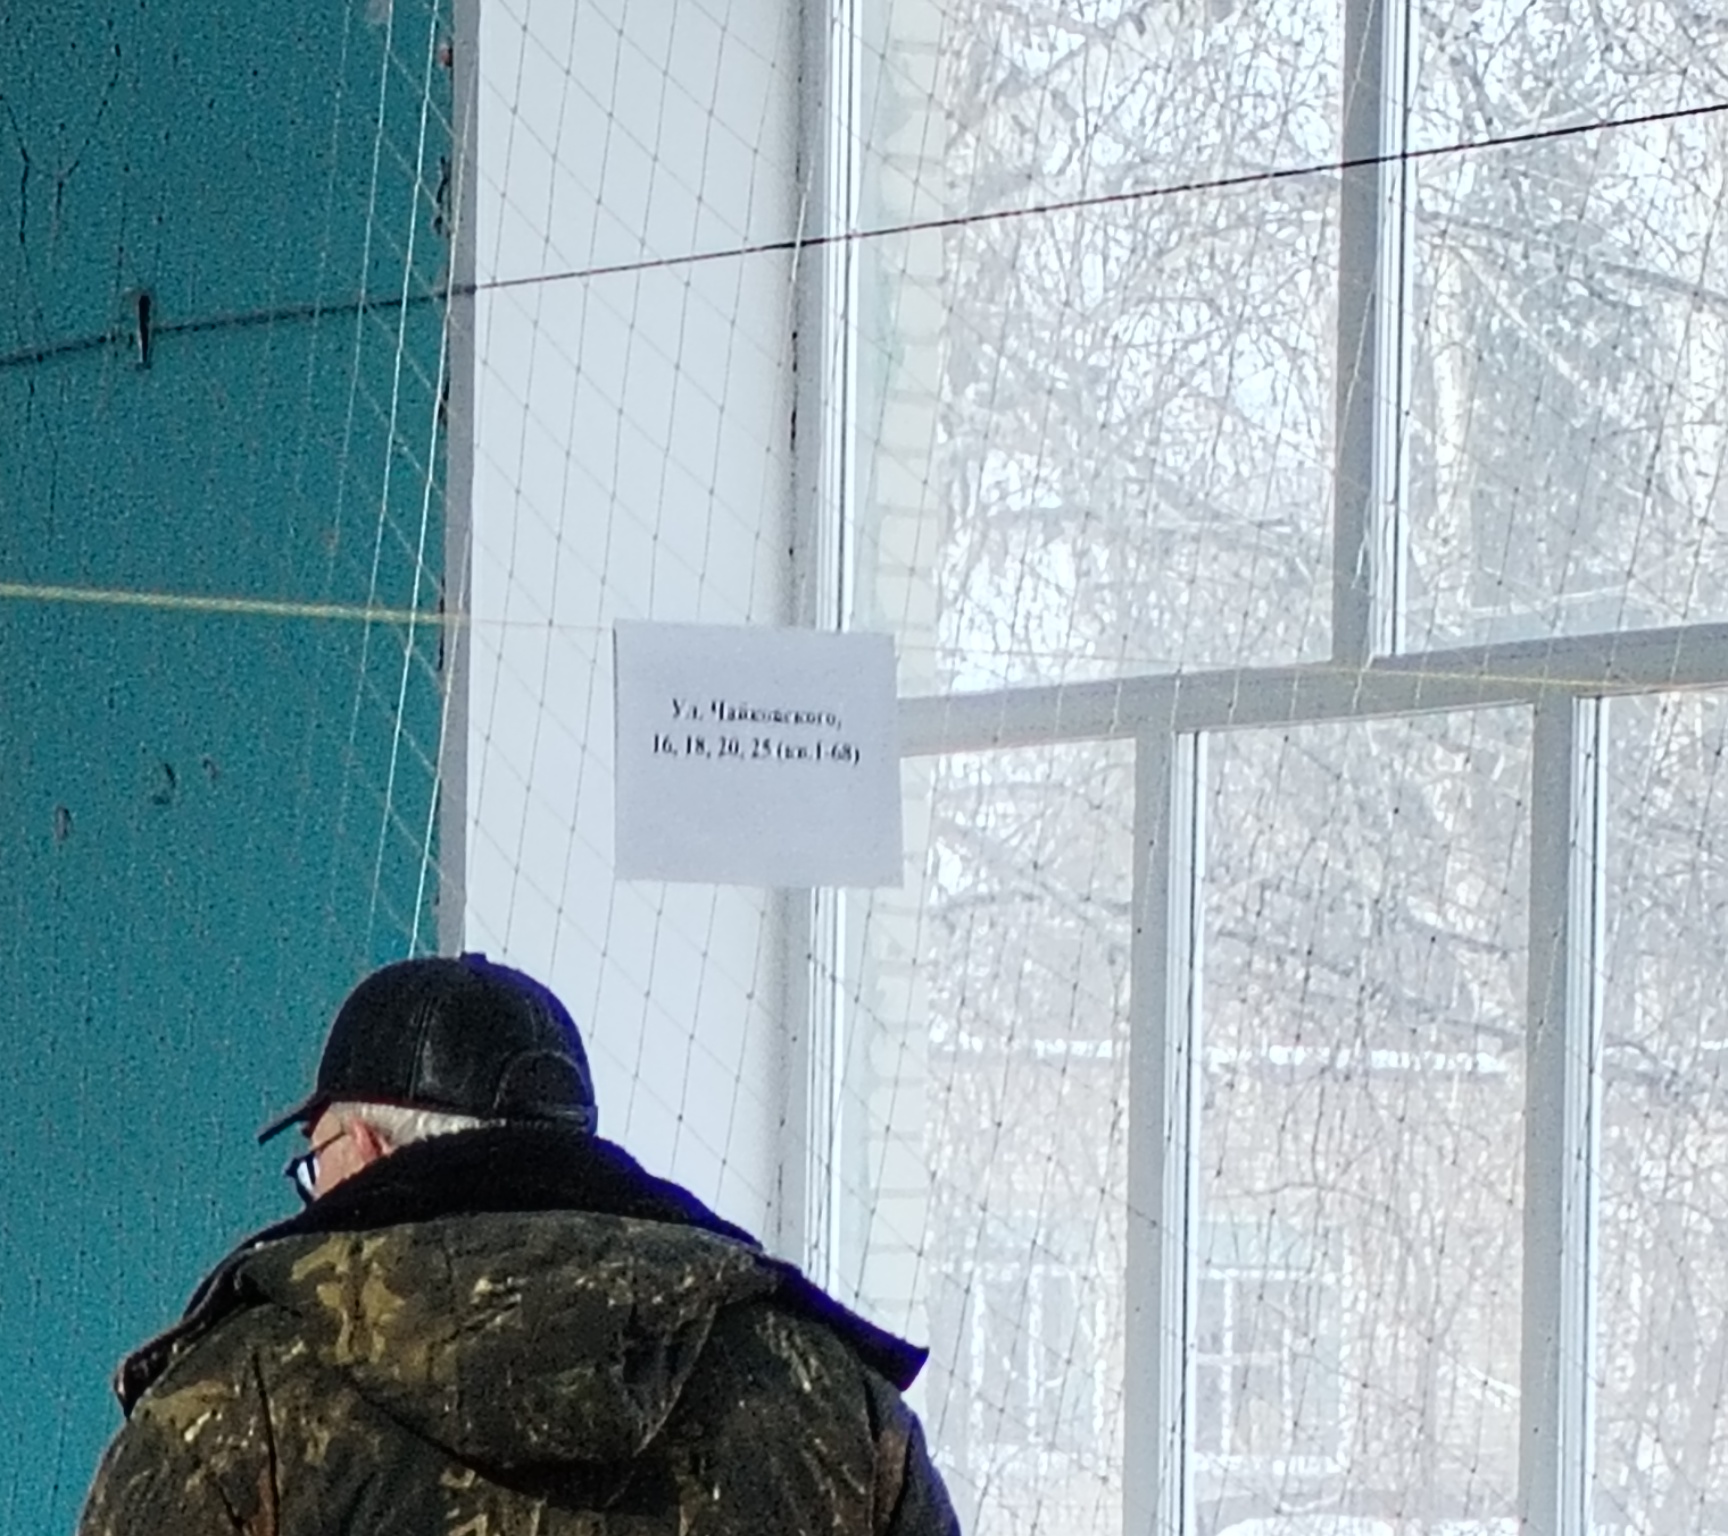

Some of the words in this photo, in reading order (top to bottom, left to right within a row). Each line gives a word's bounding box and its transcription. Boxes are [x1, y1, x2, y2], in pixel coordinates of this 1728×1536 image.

[672, 698, 703, 721] Ул.
[711, 700, 842, 730] Чайковского,
[653, 733, 678, 757] 16,
[687, 735, 711, 759] 18,
[719, 736, 744, 760] 20,
[751, 738, 771, 760] 25
